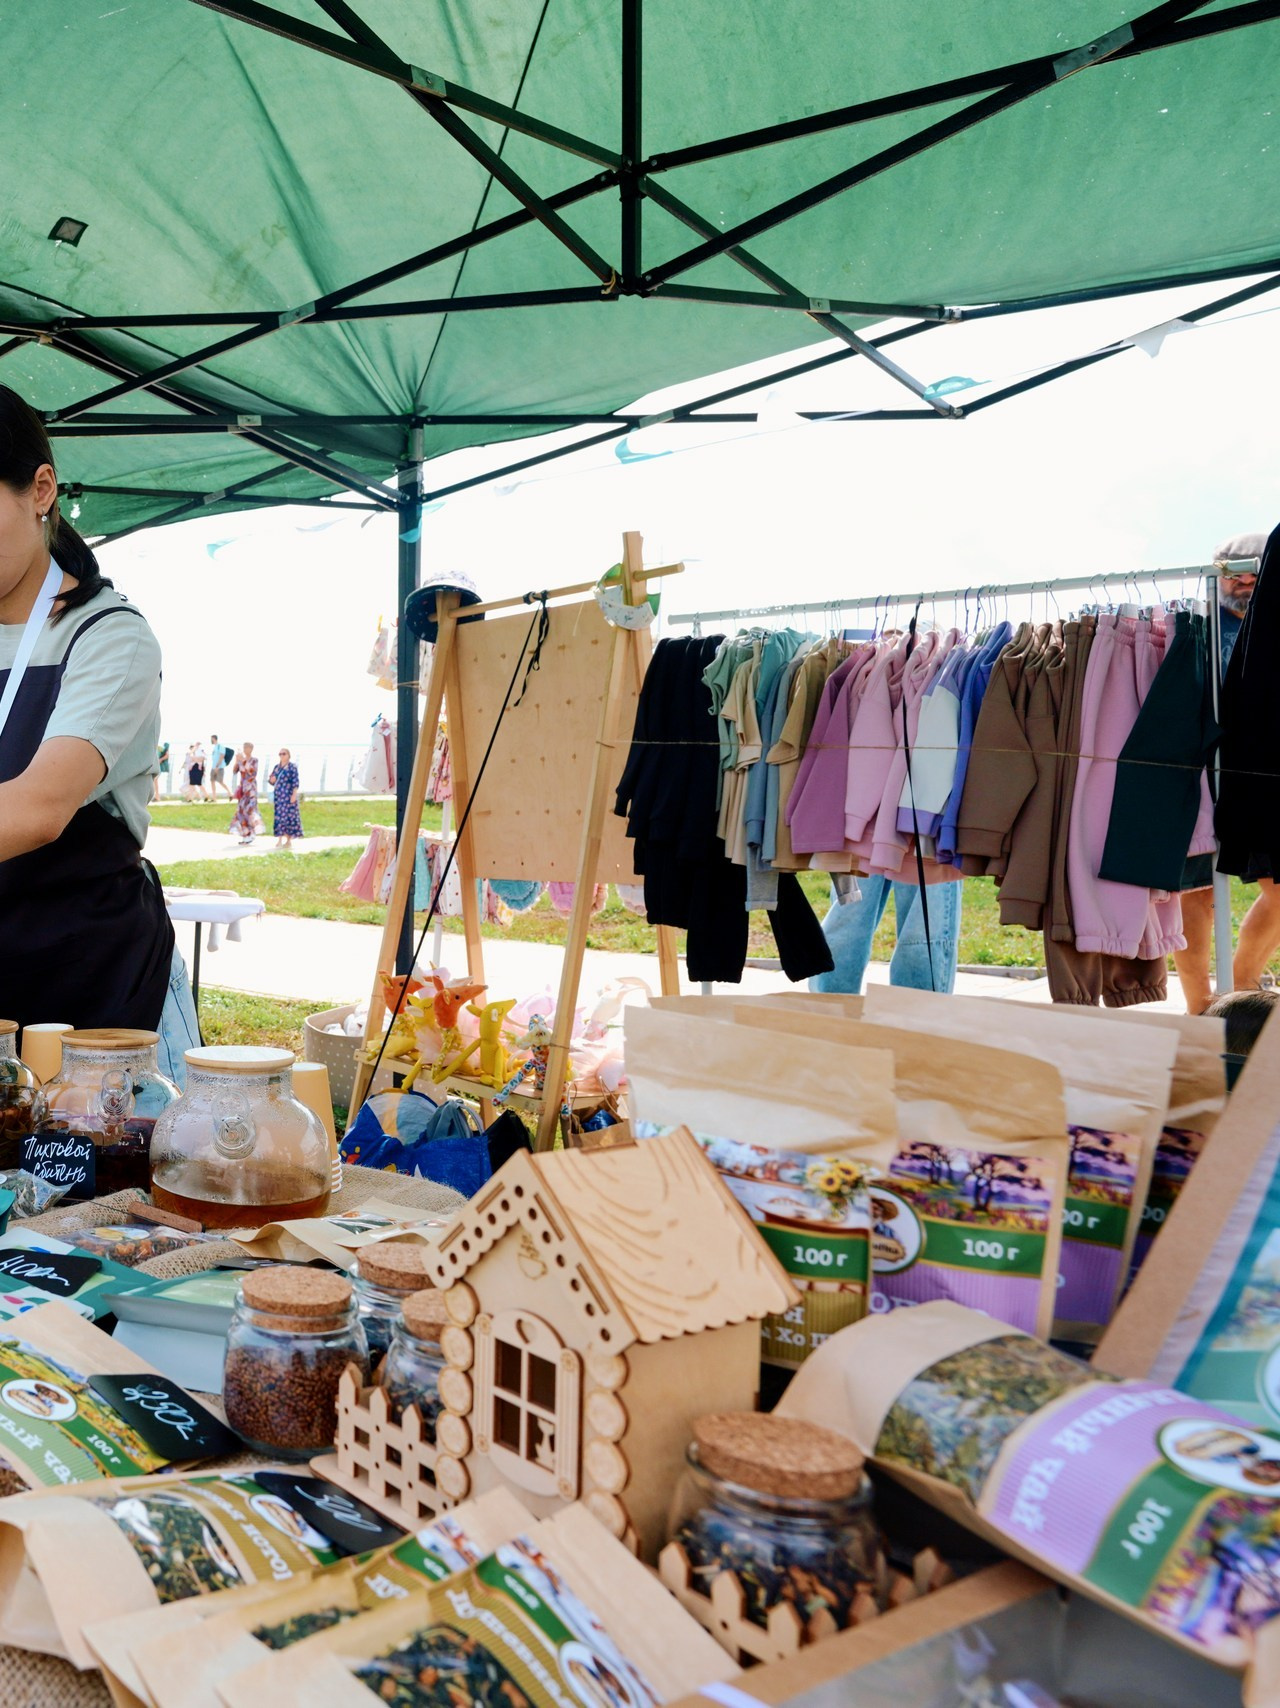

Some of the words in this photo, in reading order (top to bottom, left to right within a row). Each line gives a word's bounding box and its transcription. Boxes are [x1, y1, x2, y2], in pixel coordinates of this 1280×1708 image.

[794, 1246, 833, 1267] 100
[836, 1254, 848, 1267] г
[963, 1239, 1004, 1260] 100
[1007, 1247, 1020, 1261] г
[85, 1433, 114, 1457] 100
[1127, 1498, 1172, 1545] 100
[502, 1571, 540, 1609] чай
